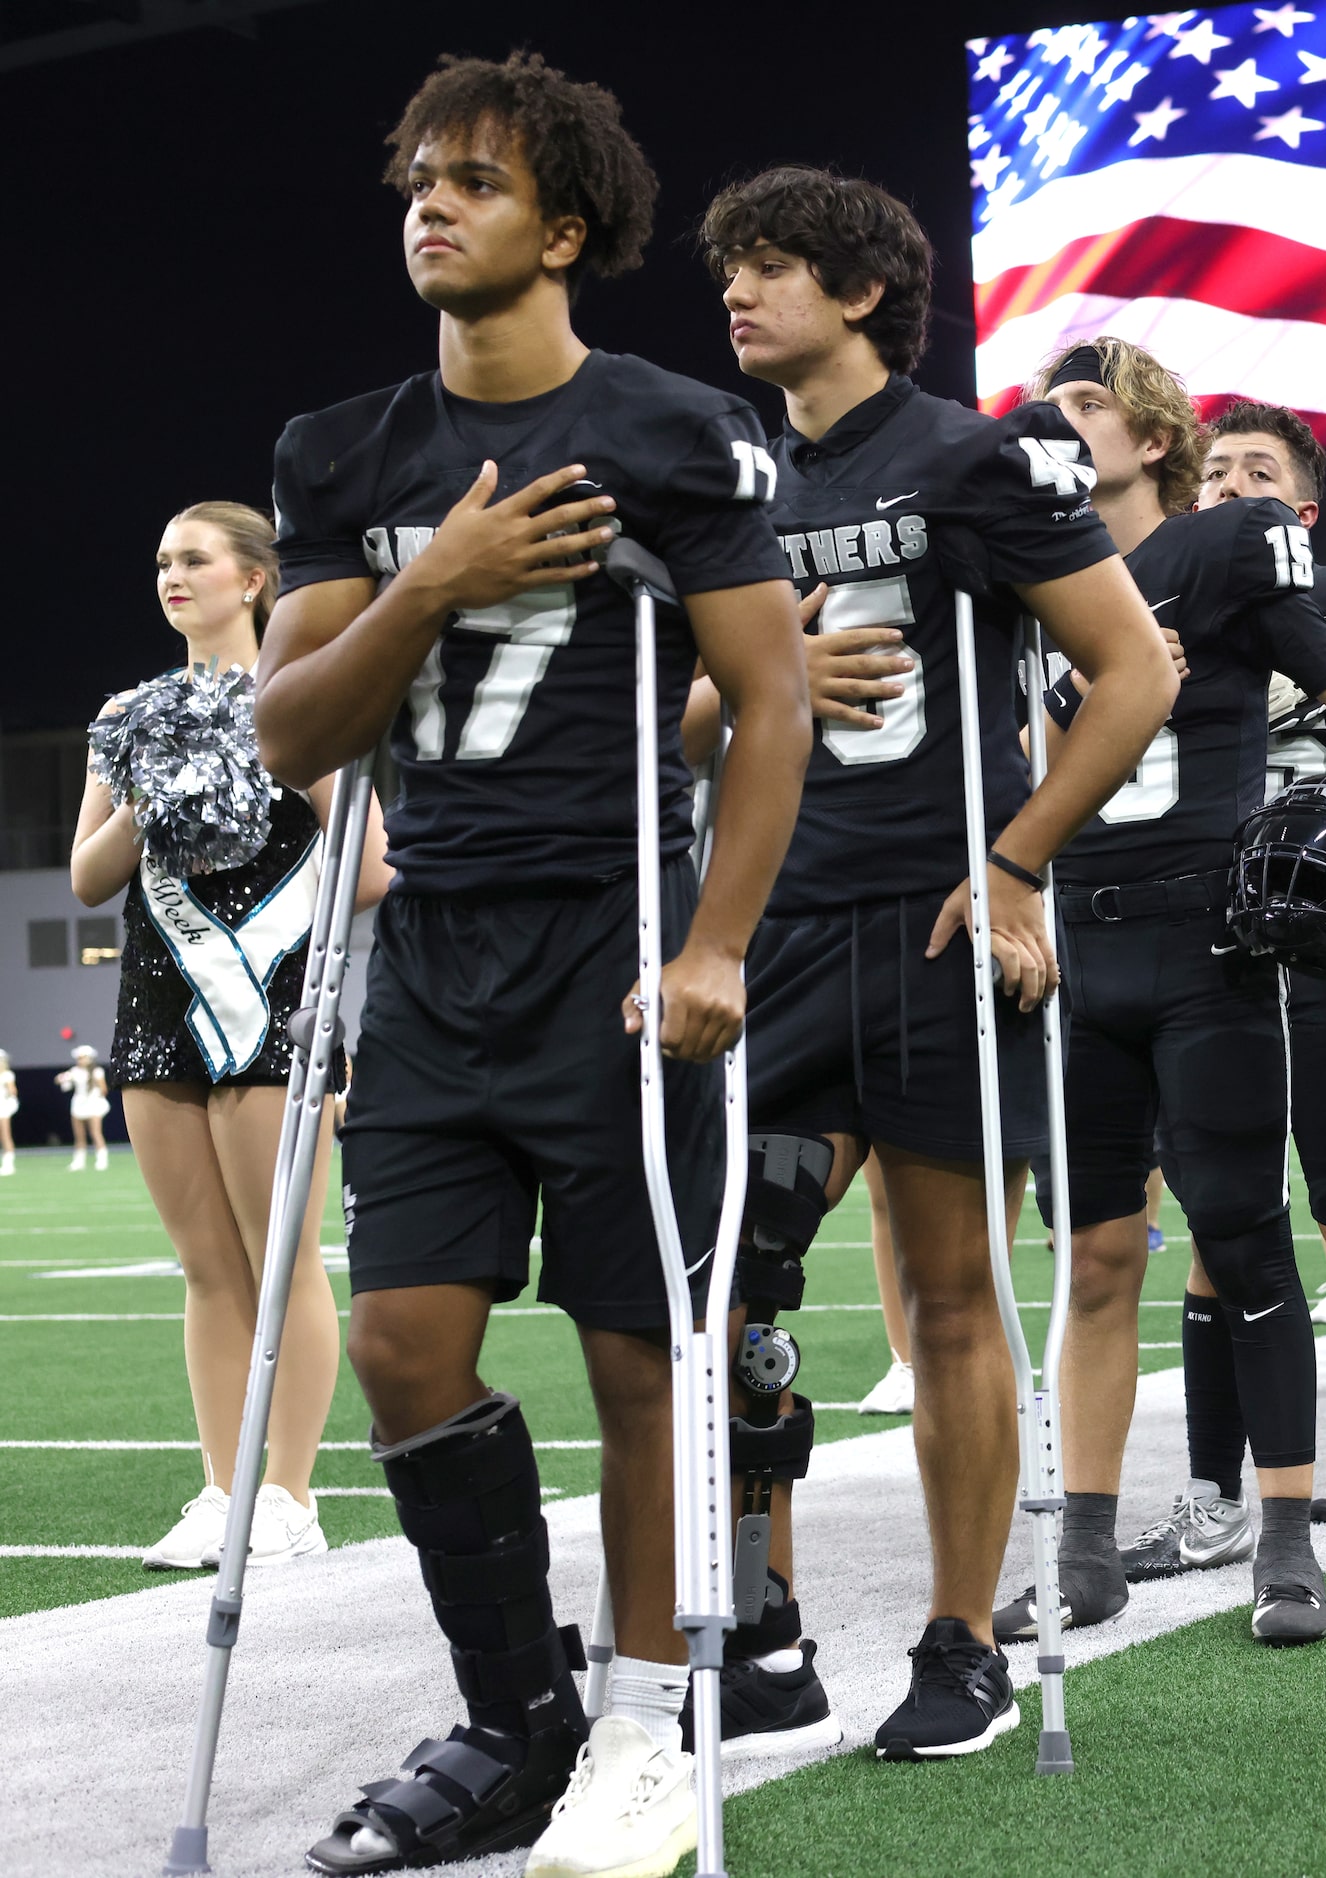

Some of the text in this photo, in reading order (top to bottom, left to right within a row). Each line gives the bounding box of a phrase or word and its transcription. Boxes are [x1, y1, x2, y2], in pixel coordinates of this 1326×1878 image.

[779, 515, 928, 579] THERS
[1263, 524, 1314, 590] 15
[150, 876, 211, 945] Week
